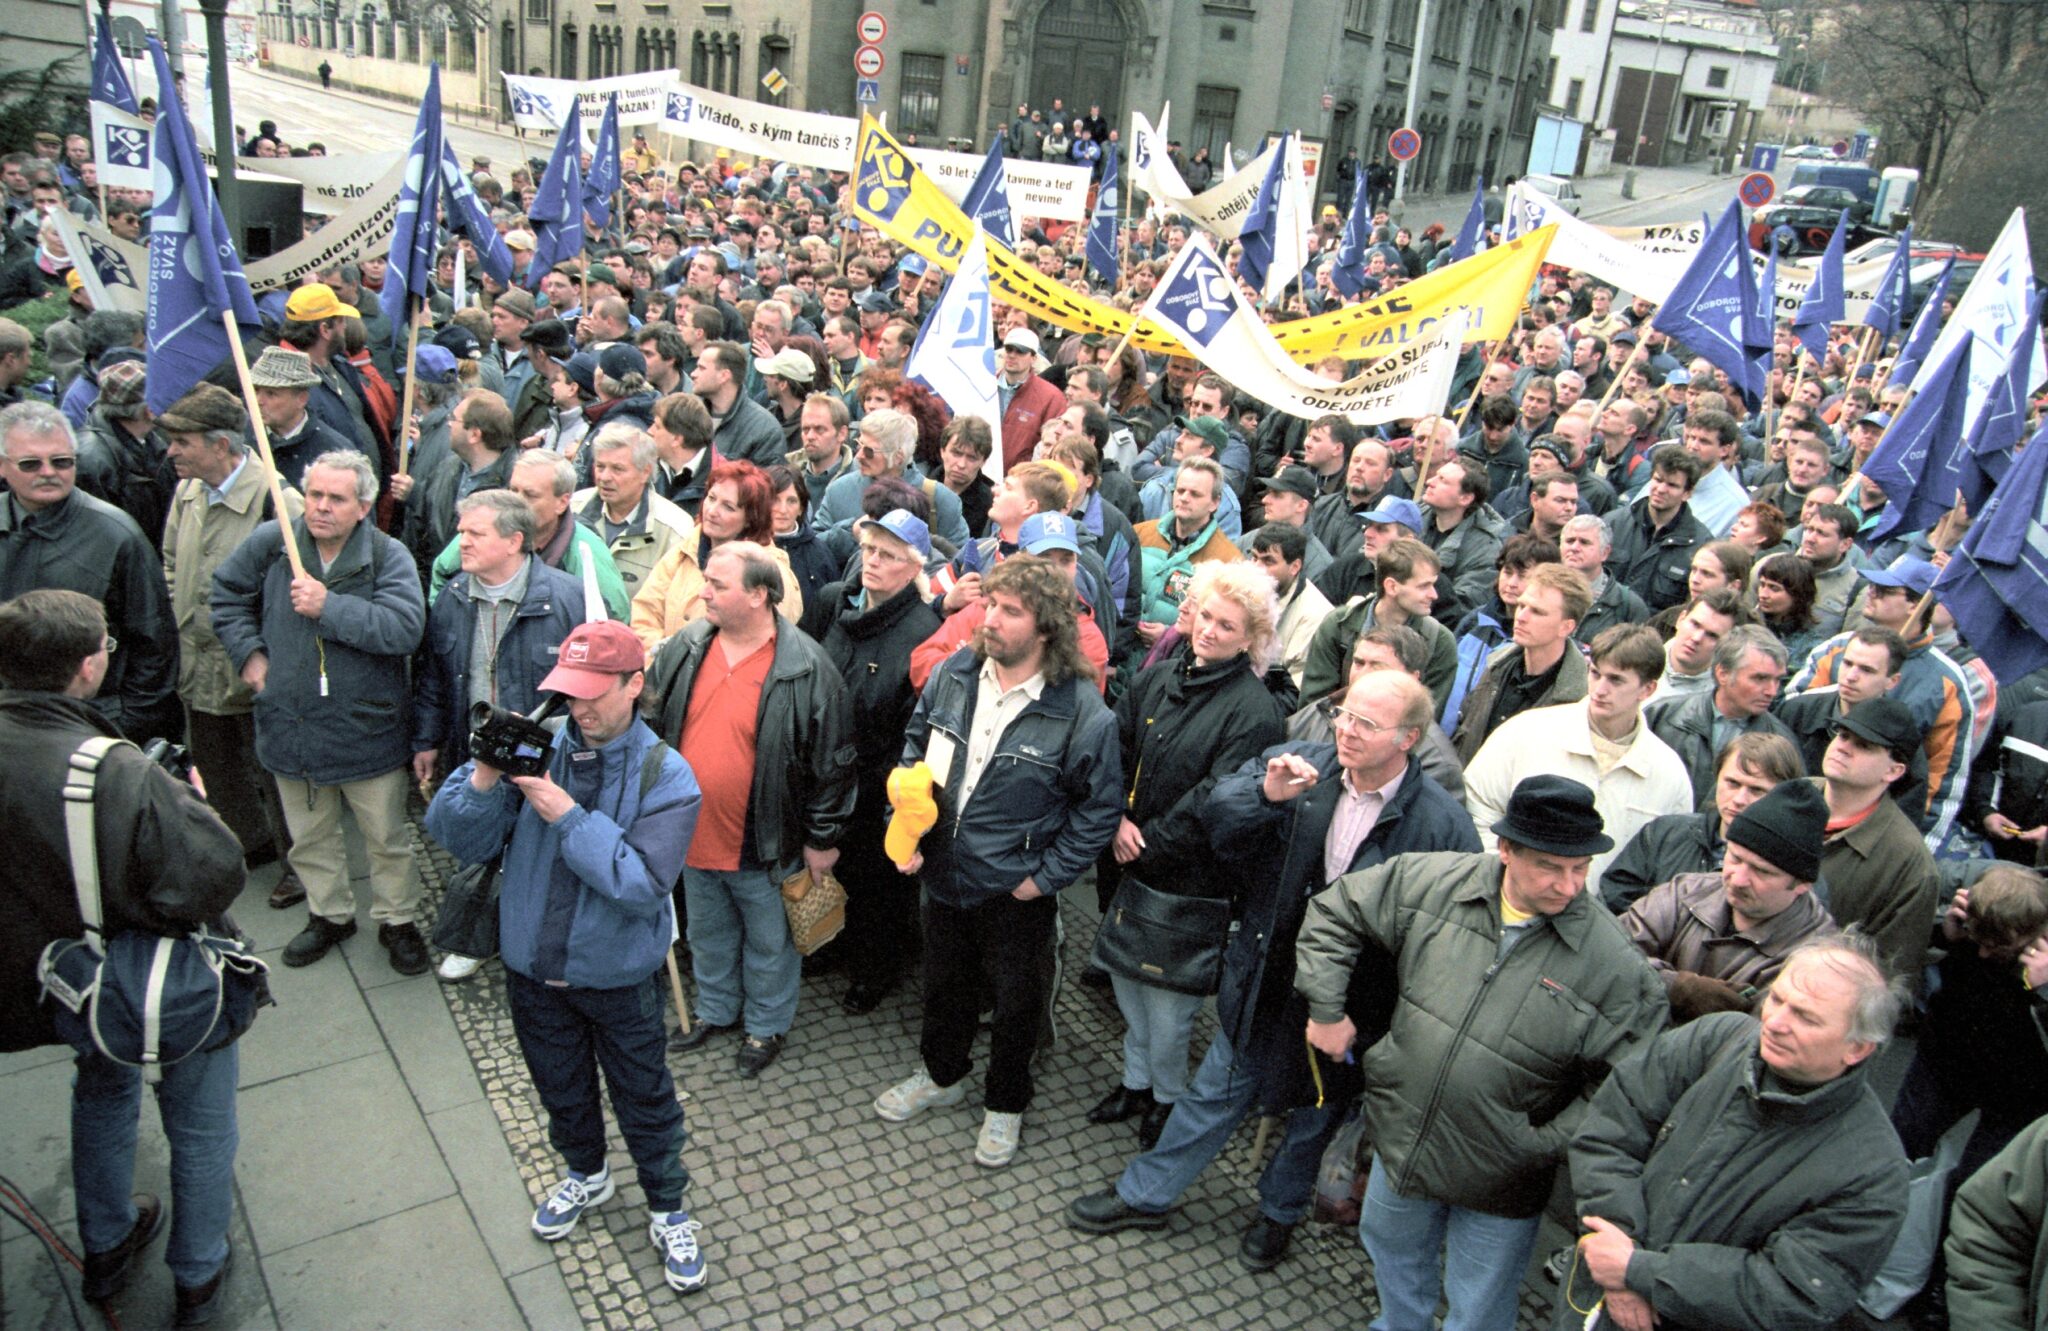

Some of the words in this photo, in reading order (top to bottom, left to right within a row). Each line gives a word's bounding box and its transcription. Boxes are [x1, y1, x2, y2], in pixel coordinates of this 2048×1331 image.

[749, 122, 758, 134] s
[939, 164, 952, 177] 50
[955, 166, 969, 178] let
[161, 234, 177, 281] SVAZ
[1696, 296, 1741, 312] ODBOROV
